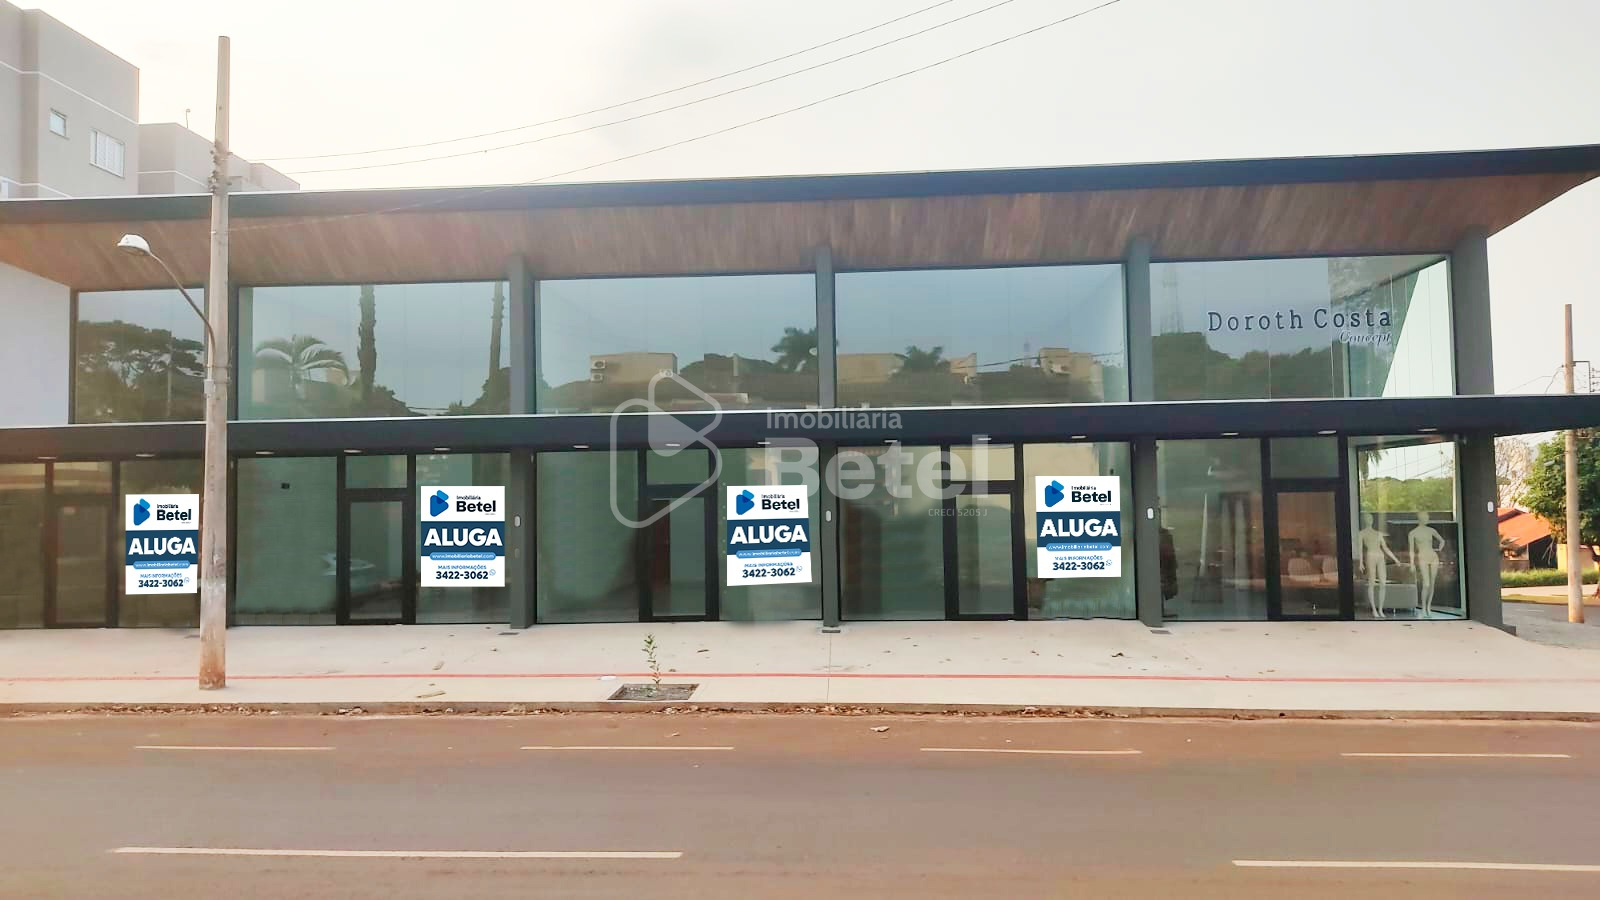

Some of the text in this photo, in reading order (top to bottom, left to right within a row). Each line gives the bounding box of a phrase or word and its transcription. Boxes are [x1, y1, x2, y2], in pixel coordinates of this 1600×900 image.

[1208, 308, 1391, 331] Doroth Costa
[1071, 490, 1112, 503] Betel
[456, 500, 496, 512] Betel
[761, 498, 800, 510] Betel
[156, 508, 192, 521] Betel
[730, 524, 808, 545] ALUGA
[1040, 518, 1119, 538] ALUGA
[423, 528, 503, 547] ALUGA
[128, 536, 197, 555] ALUGA
[742, 567, 796, 578] 3422-3062
[1052, 561, 1105, 571] 3422-3062
[435, 571, 489, 580] 3422-3062
[138, 579, 184, 588] 3422-3062
